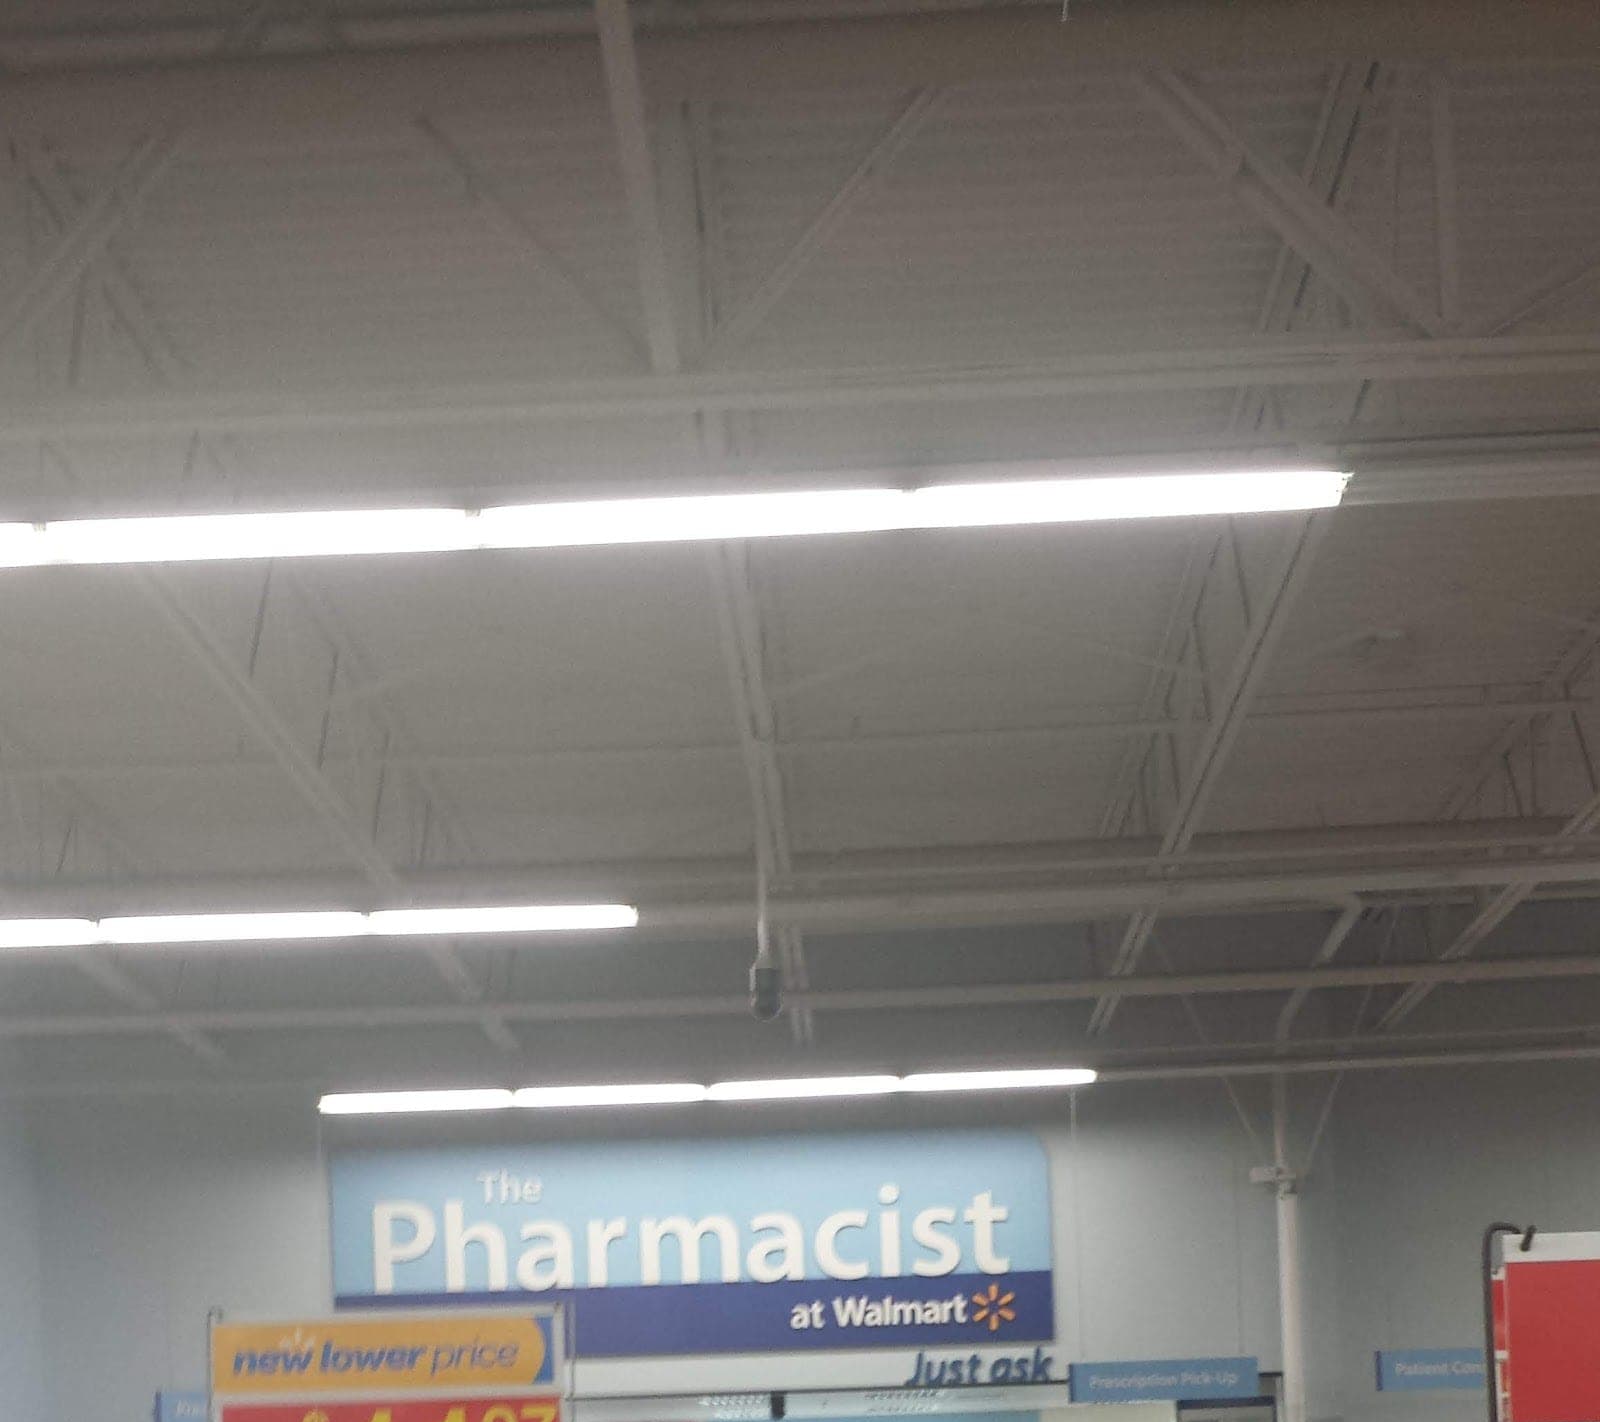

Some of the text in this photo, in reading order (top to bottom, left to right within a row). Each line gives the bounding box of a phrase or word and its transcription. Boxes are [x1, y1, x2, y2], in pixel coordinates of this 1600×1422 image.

[477, 1168, 542, 1204] The
[371, 1184, 1012, 1295] Pharmacist
[790, 1295, 968, 1331] at Walmart
[232, 1336, 521, 1377] new lower price
[905, 1346, 1055, 1387] Just ask
